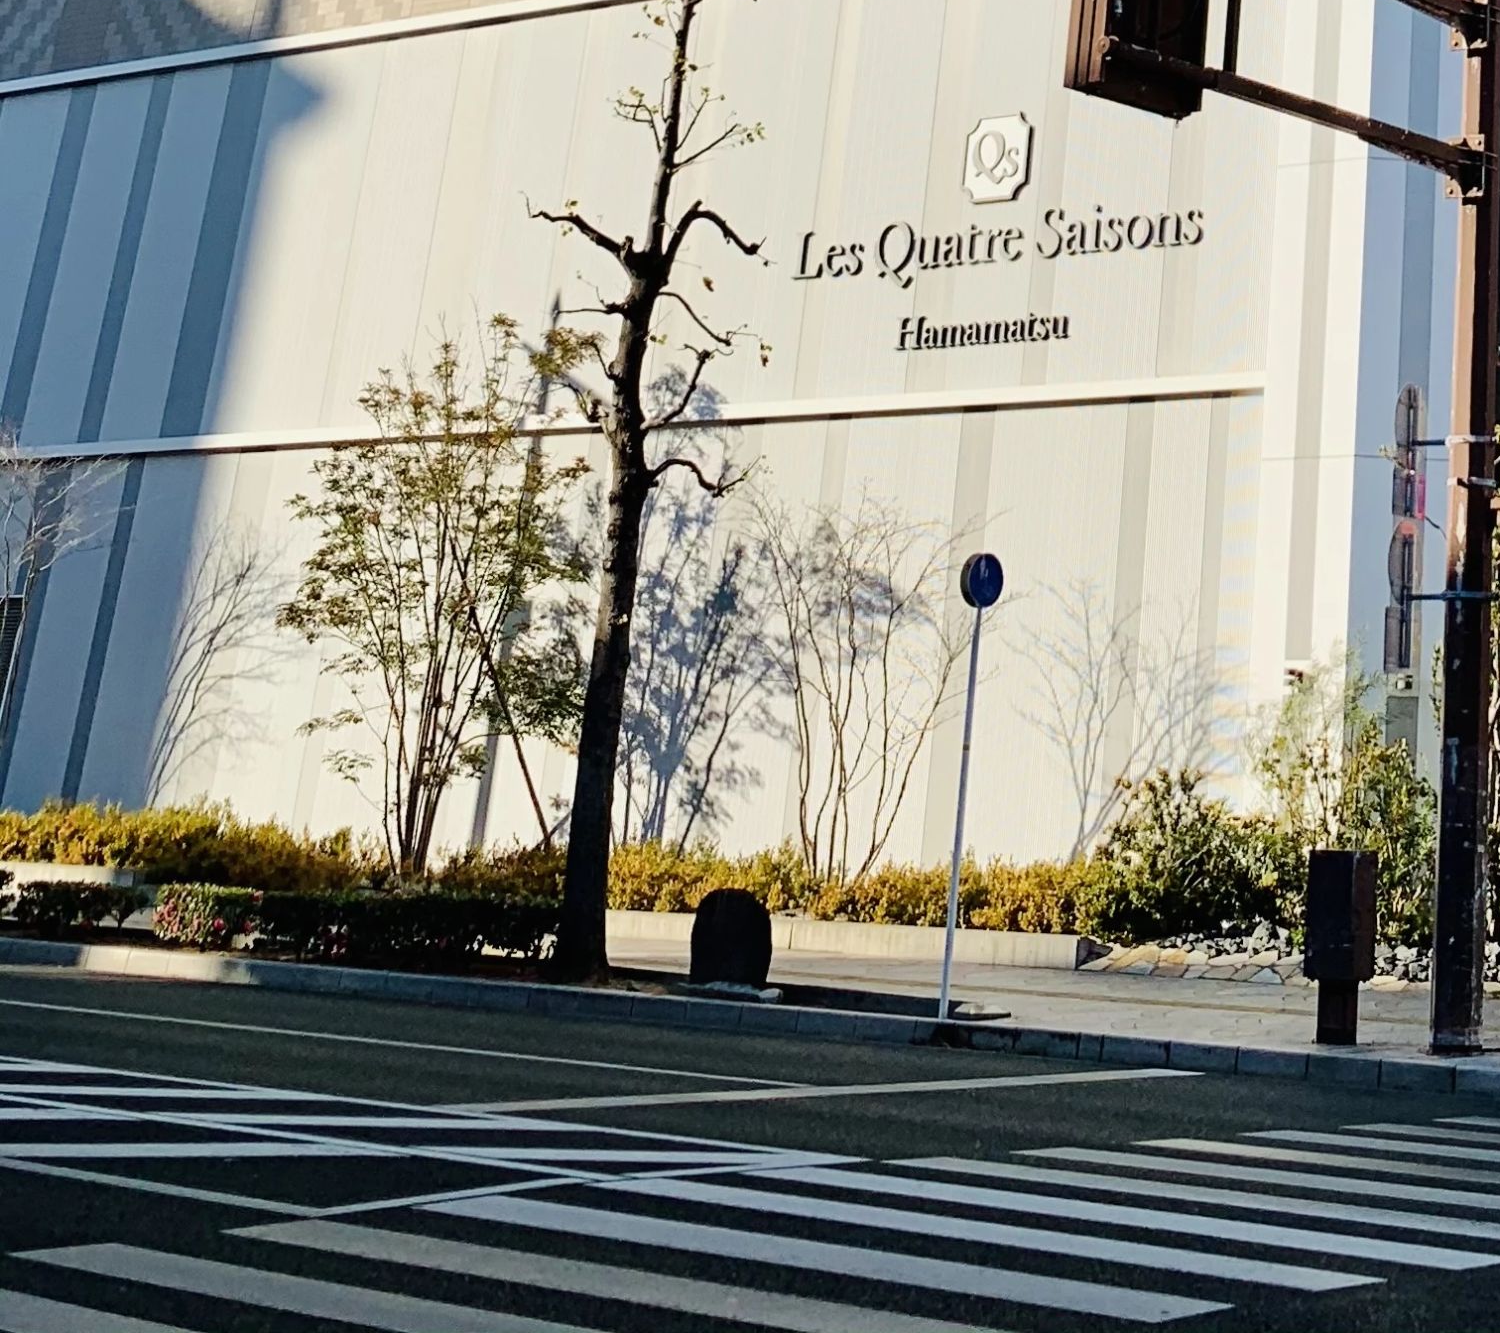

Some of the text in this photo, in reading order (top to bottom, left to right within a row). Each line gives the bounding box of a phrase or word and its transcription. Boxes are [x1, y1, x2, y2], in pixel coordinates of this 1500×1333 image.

[972, 131, 1019, 185] Qs
[791, 205, 1204, 289] Les Quatre Saisons
[895, 311, 1071, 352] Hamamatsu
